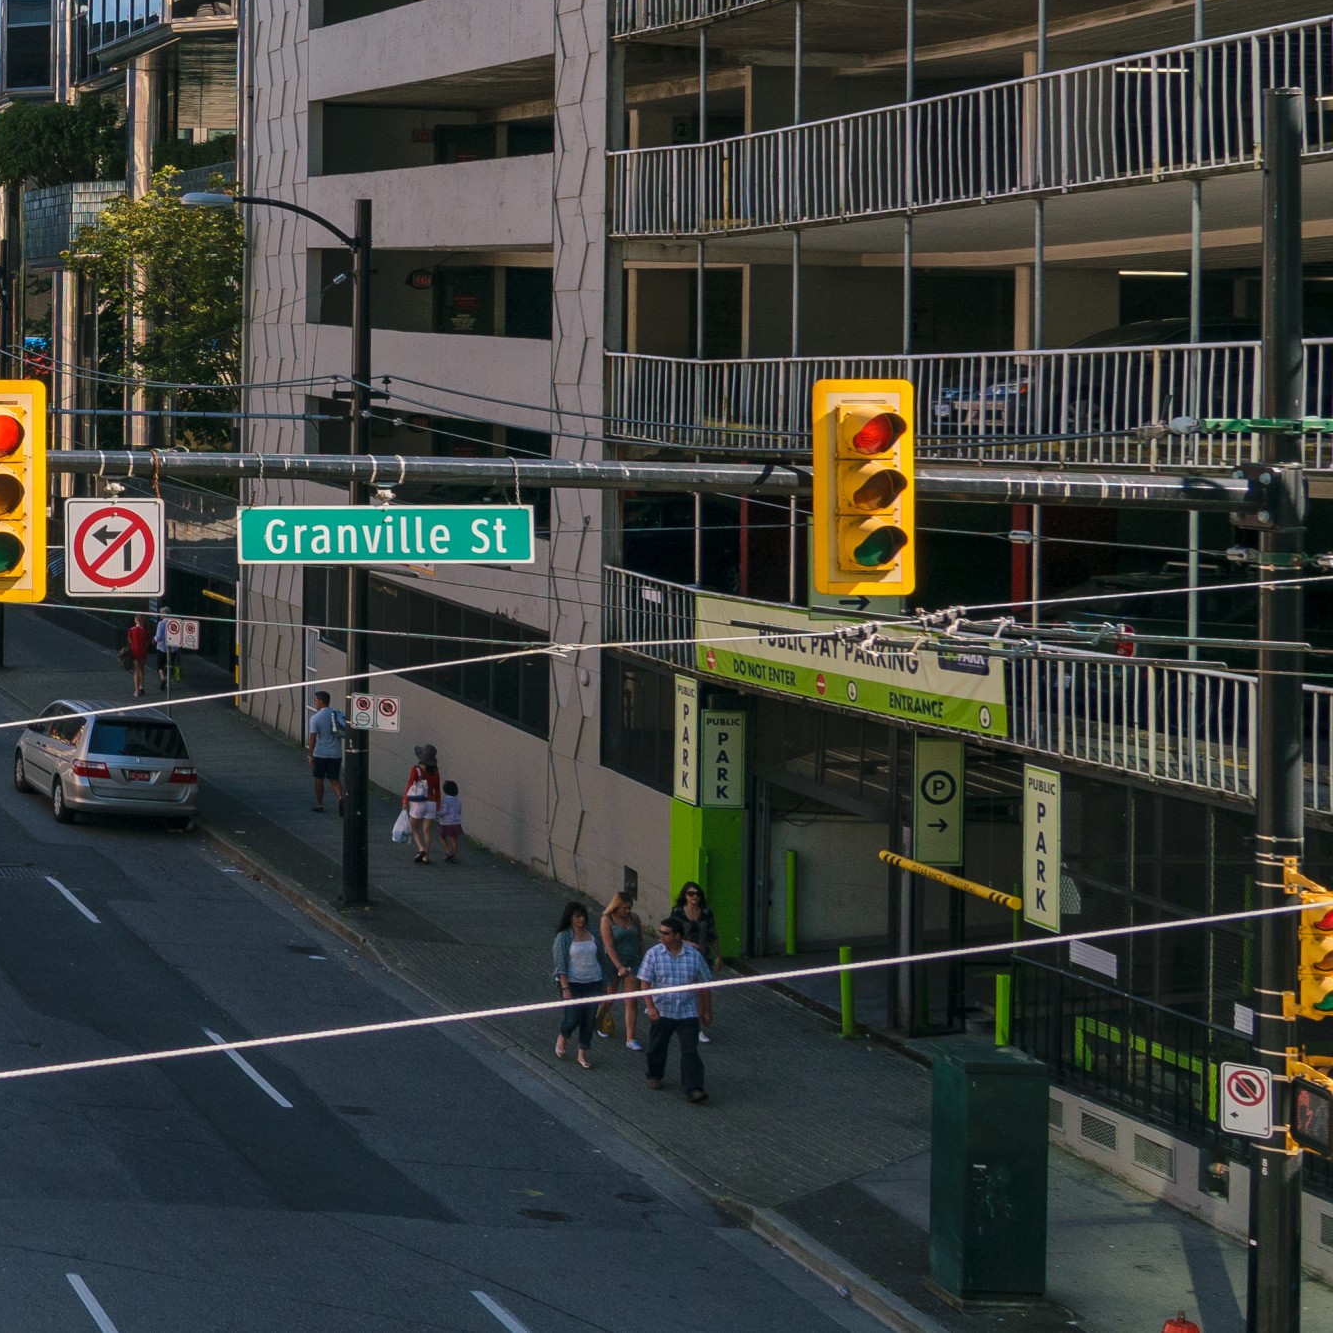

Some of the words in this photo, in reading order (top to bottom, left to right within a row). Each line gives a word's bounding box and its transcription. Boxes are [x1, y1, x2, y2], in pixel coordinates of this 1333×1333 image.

[264, 516, 451, 555] Granville
[470, 517, 508, 554] St
[758, 621, 807, 654] PUBLIC
[811, 634, 839, 659] PAY
[844, 641, 920, 675] PARKING
[733, 658, 747, 675] DO
[748, 662, 767, 680] NOT
[769, 666, 796, 687] ENTER
[677, 684, 695, 698] PUBLIC
[888, 691, 944, 719] ENTRANCE
[706, 717, 741, 726] PUBLIC
[681, 703, 690, 790] PARK
[715, 732, 730, 799] PARK
[932, 779, 946, 796] P
[1027, 777, 1056, 796] PUBLIC
[1035, 801, 1047, 913] PARK
